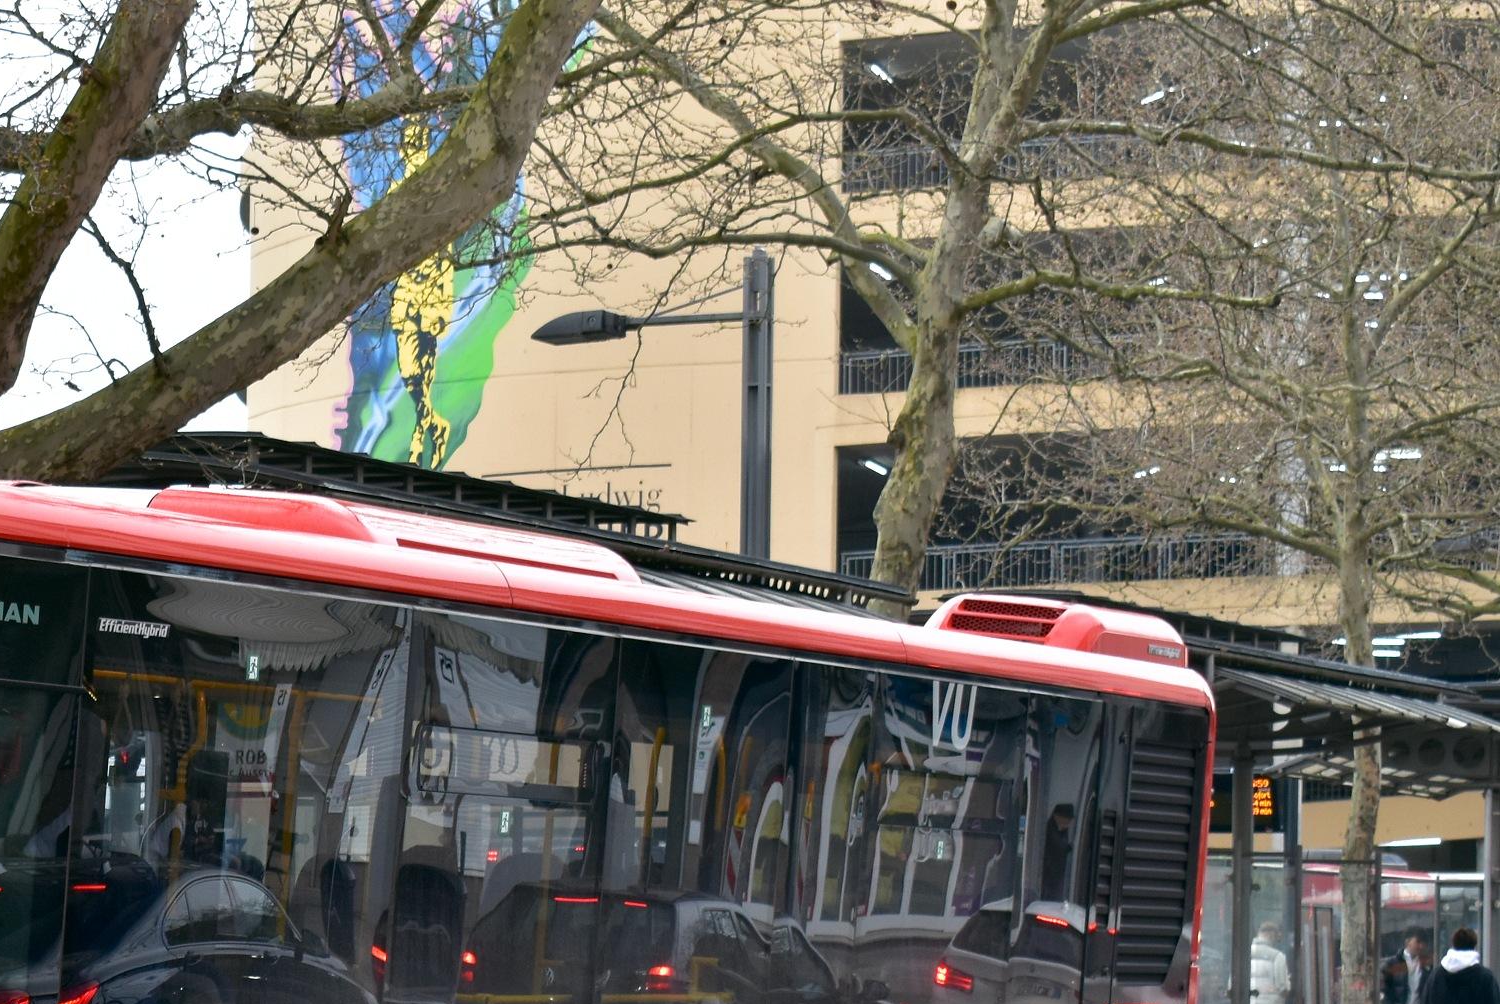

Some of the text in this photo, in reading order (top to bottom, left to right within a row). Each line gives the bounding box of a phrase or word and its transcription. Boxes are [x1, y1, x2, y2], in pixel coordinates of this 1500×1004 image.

[99, 618, 171, 639] EfficientHybrid
[933, 680, 978, 750] VU
[236, 749, 268, 765] ROB
[1260, 800, 1271, 808] min
[1260, 808, 1272, 816] min
